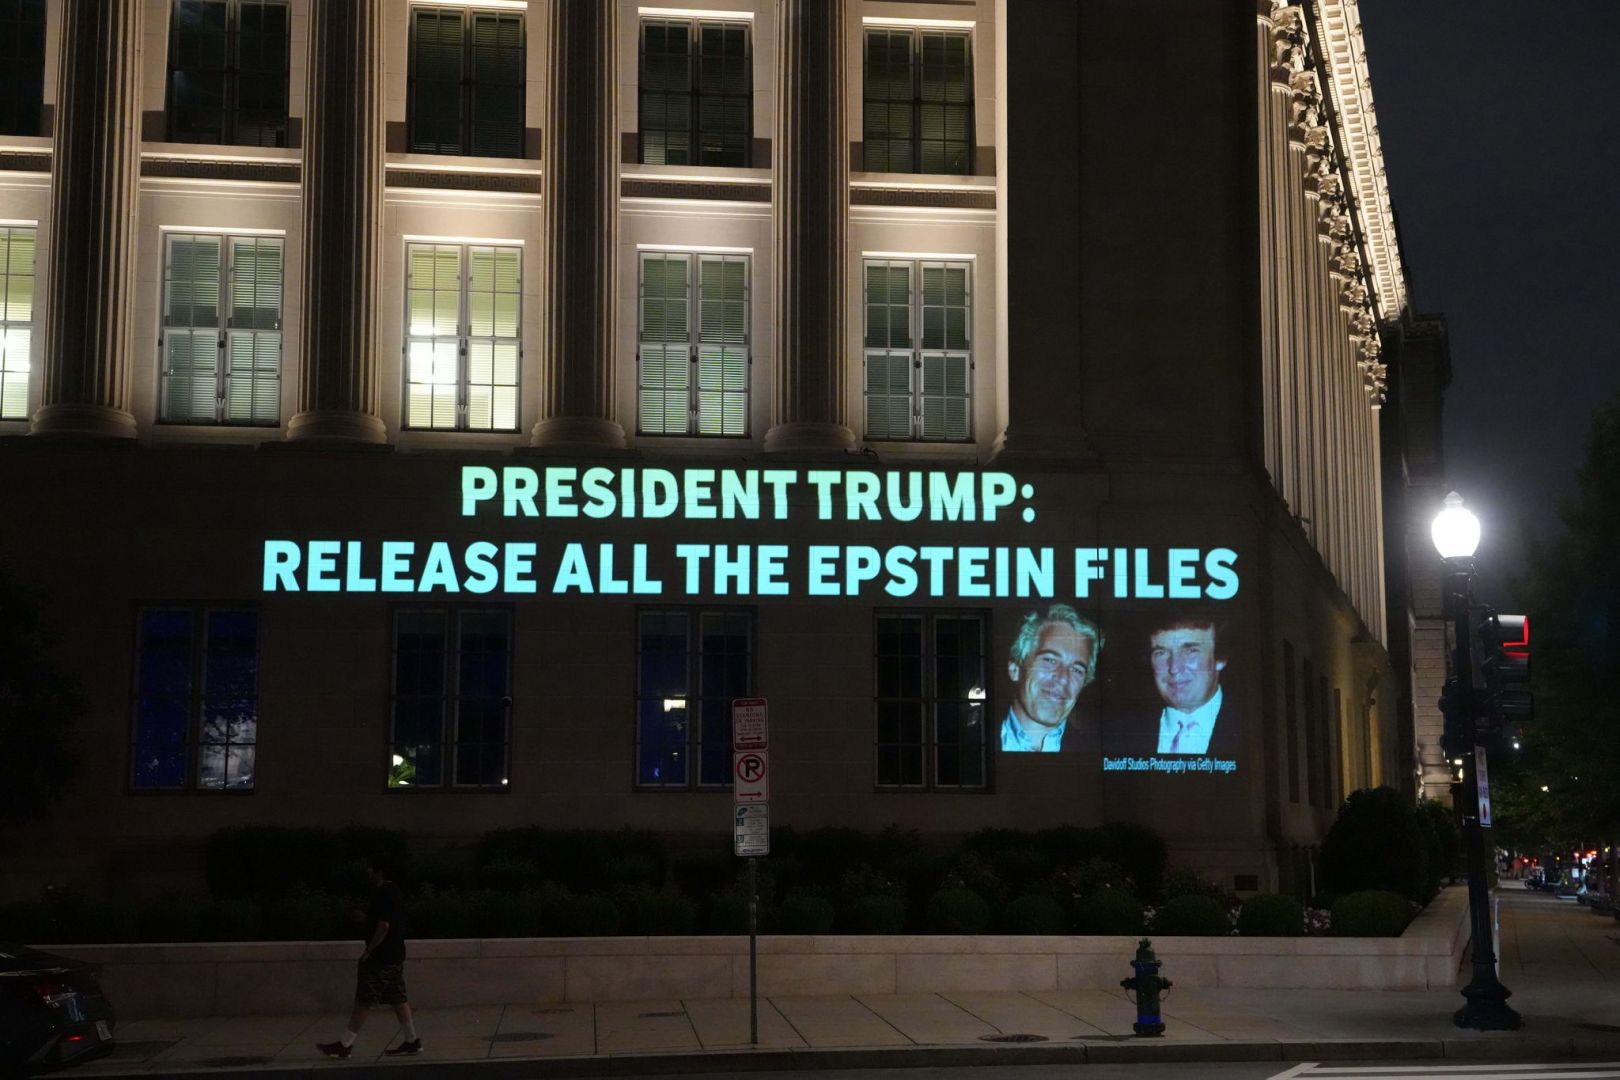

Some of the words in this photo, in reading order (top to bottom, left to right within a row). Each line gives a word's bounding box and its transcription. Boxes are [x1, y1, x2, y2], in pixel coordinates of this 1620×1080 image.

[461, 465, 798, 520] PRESIDENT
[807, 470, 1036, 523] TRUMP:
[262, 539, 537, 594] RELEASE
[552, 542, 663, 595] ALL
[675, 543, 790, 596] THE
[808, 545, 1055, 598] EPSTEIN
[1074, 547, 1240, 600] FILES
[1128, 757, 1149, 770] Studios
[1150, 757, 1186, 773] Photography
[1187, 758, 1196, 770] via
[1197, 757, 1214, 773] Getty
[1214, 757, 1236, 773] Images
